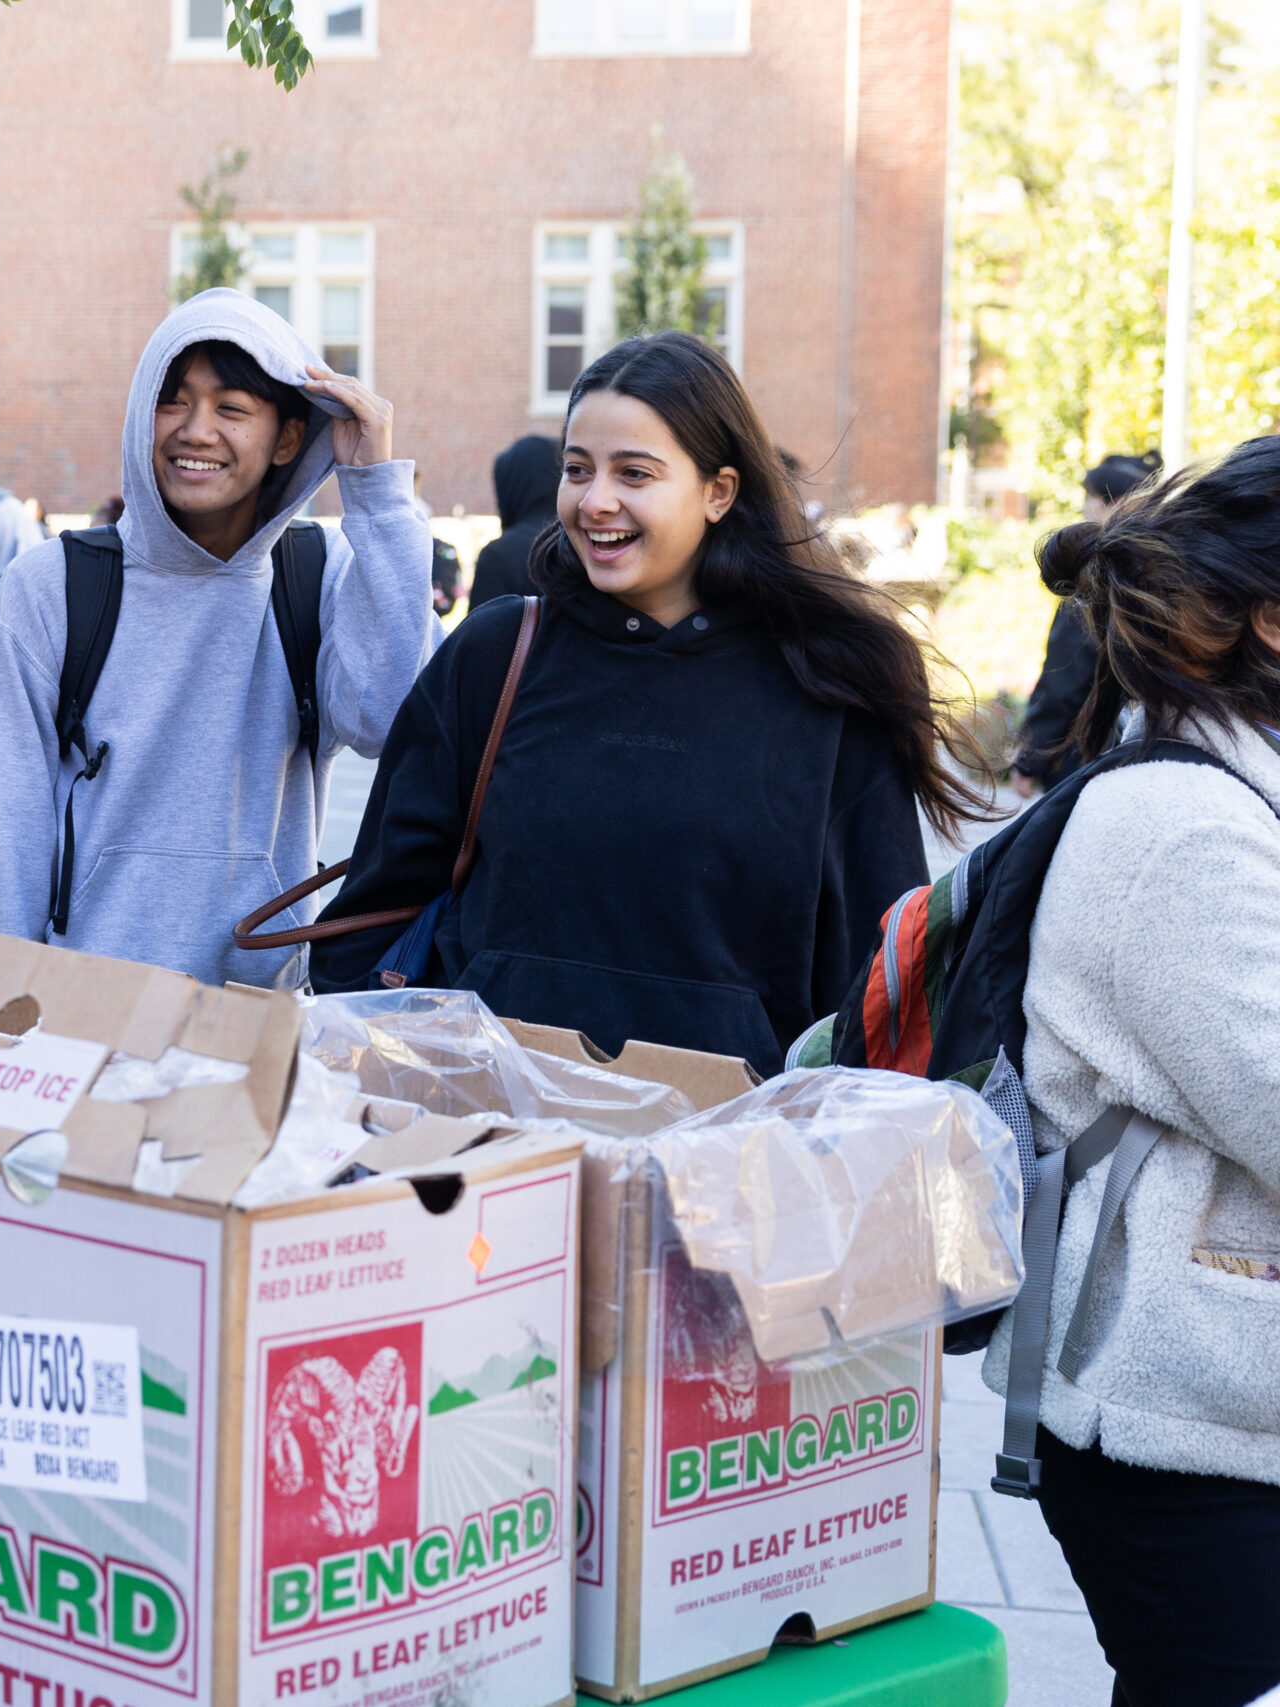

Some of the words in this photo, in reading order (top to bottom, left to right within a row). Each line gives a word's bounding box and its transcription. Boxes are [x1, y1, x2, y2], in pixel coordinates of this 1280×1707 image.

[33, 1074, 79, 1102] ICE
[261, 1248, 271, 1270] 2
[276, 1240, 329, 1267] DOZEN
[334, 1229, 387, 1257] HEADS
[258, 1278, 291, 1301] RED
[296, 1270, 334, 1297] LEAF
[338, 1259, 406, 1289] LETTUCE
[12, 1418, 36, 1443] LEAF
[40, 1420, 60, 1446] RED
[667, 1390, 918, 1502] BENGARD
[670, 1549, 724, 1587] RED
[733, 1528, 796, 1570] LEAF
[804, 1493, 908, 1550] LETTUCE
[269, 1491, 556, 1631] BENGARD
[742, 1572, 784, 1596] BENGARD
[785, 1562, 818, 1584] RANCH,
[820, 1556, 837, 1573] INC.
[760, 1584, 794, 1604] PRODUCE
[795, 1581, 805, 1594] OF
[276, 1658, 341, 1700] RED
[352, 1632, 429, 1679] LEAF
[438, 1586, 548, 1655] LETTUCE
